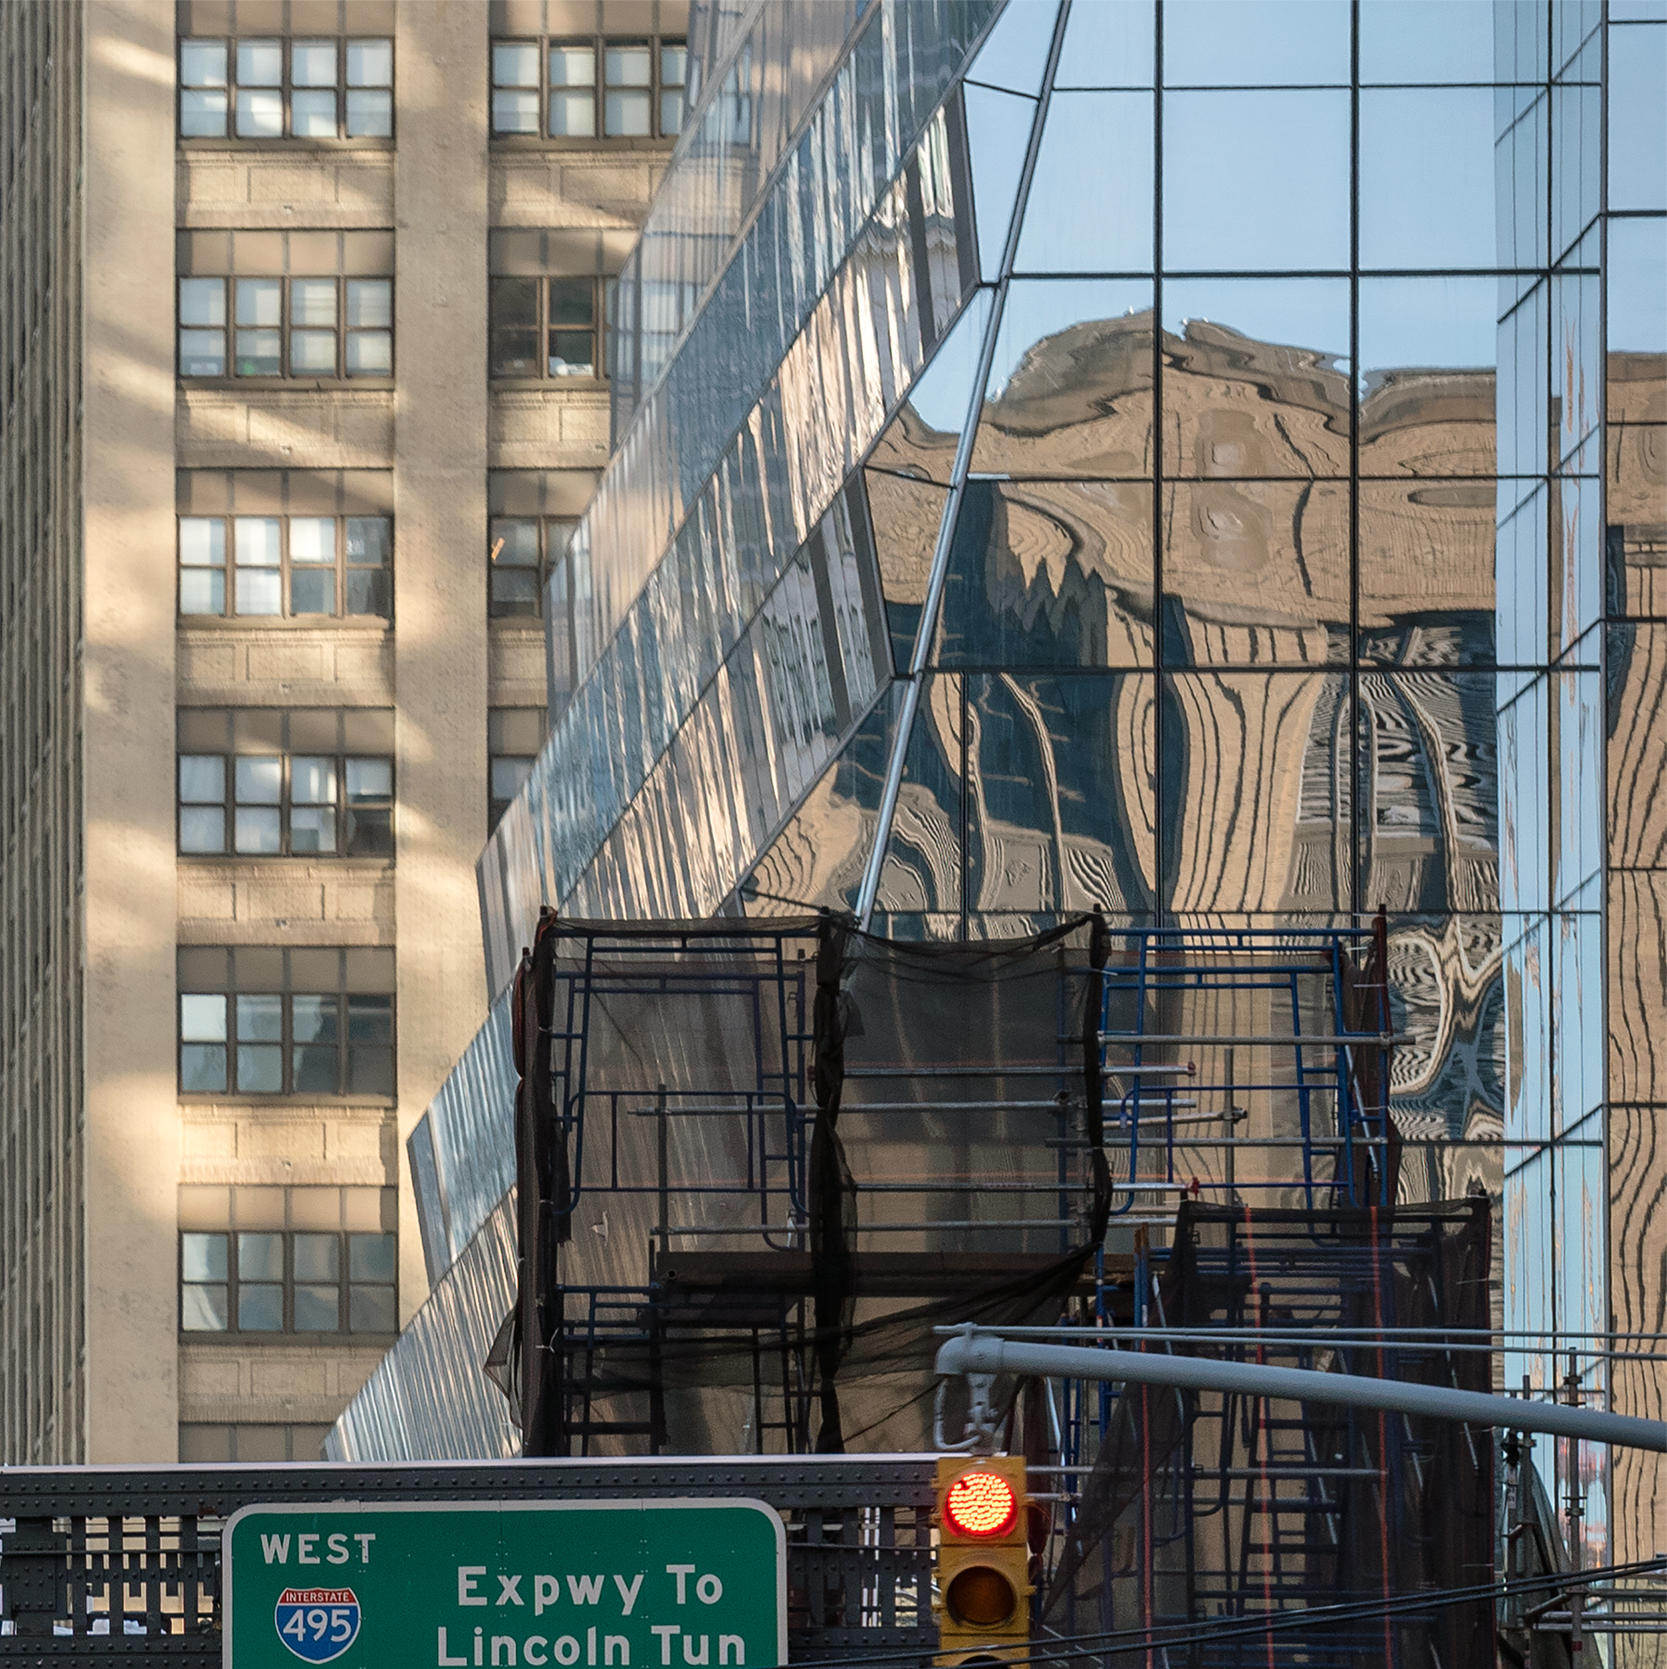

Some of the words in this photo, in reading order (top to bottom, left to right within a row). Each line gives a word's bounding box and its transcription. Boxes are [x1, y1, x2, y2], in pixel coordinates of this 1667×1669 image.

[261, 1533, 376, 1565] WEST
[285, 1592, 350, 1602] INTERSTATE
[457, 1564, 644, 1616] Expwy
[667, 1564, 723, 1606] To
[283, 1609, 352, 1643] 495
[438, 1625, 631, 1667] Lincoln
[651, 1625, 746, 1667] Tun
